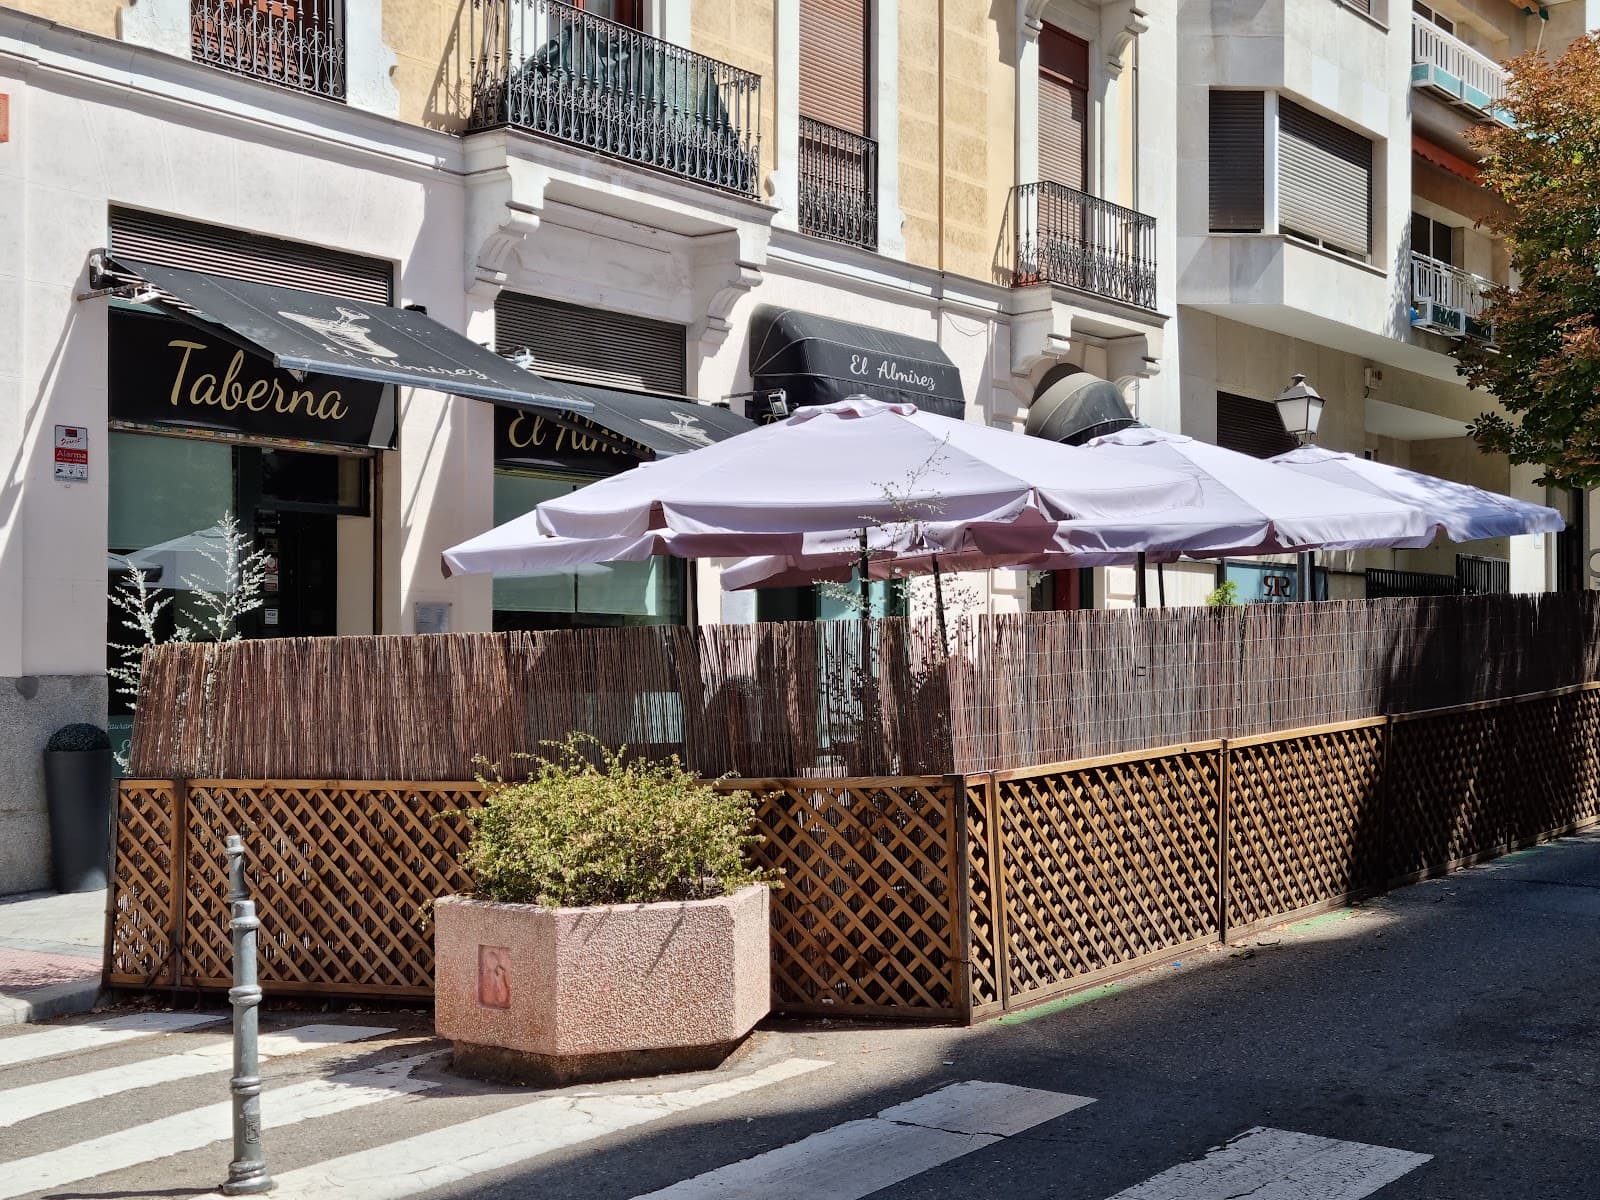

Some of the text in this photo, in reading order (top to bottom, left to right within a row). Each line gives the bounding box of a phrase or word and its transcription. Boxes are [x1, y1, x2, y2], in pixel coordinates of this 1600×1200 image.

[168, 340, 349, 420] Taberna
[850, 354, 936, 391] El Almirez
[508, 409, 547, 448] El
[56, 449, 87, 459] Alarma
